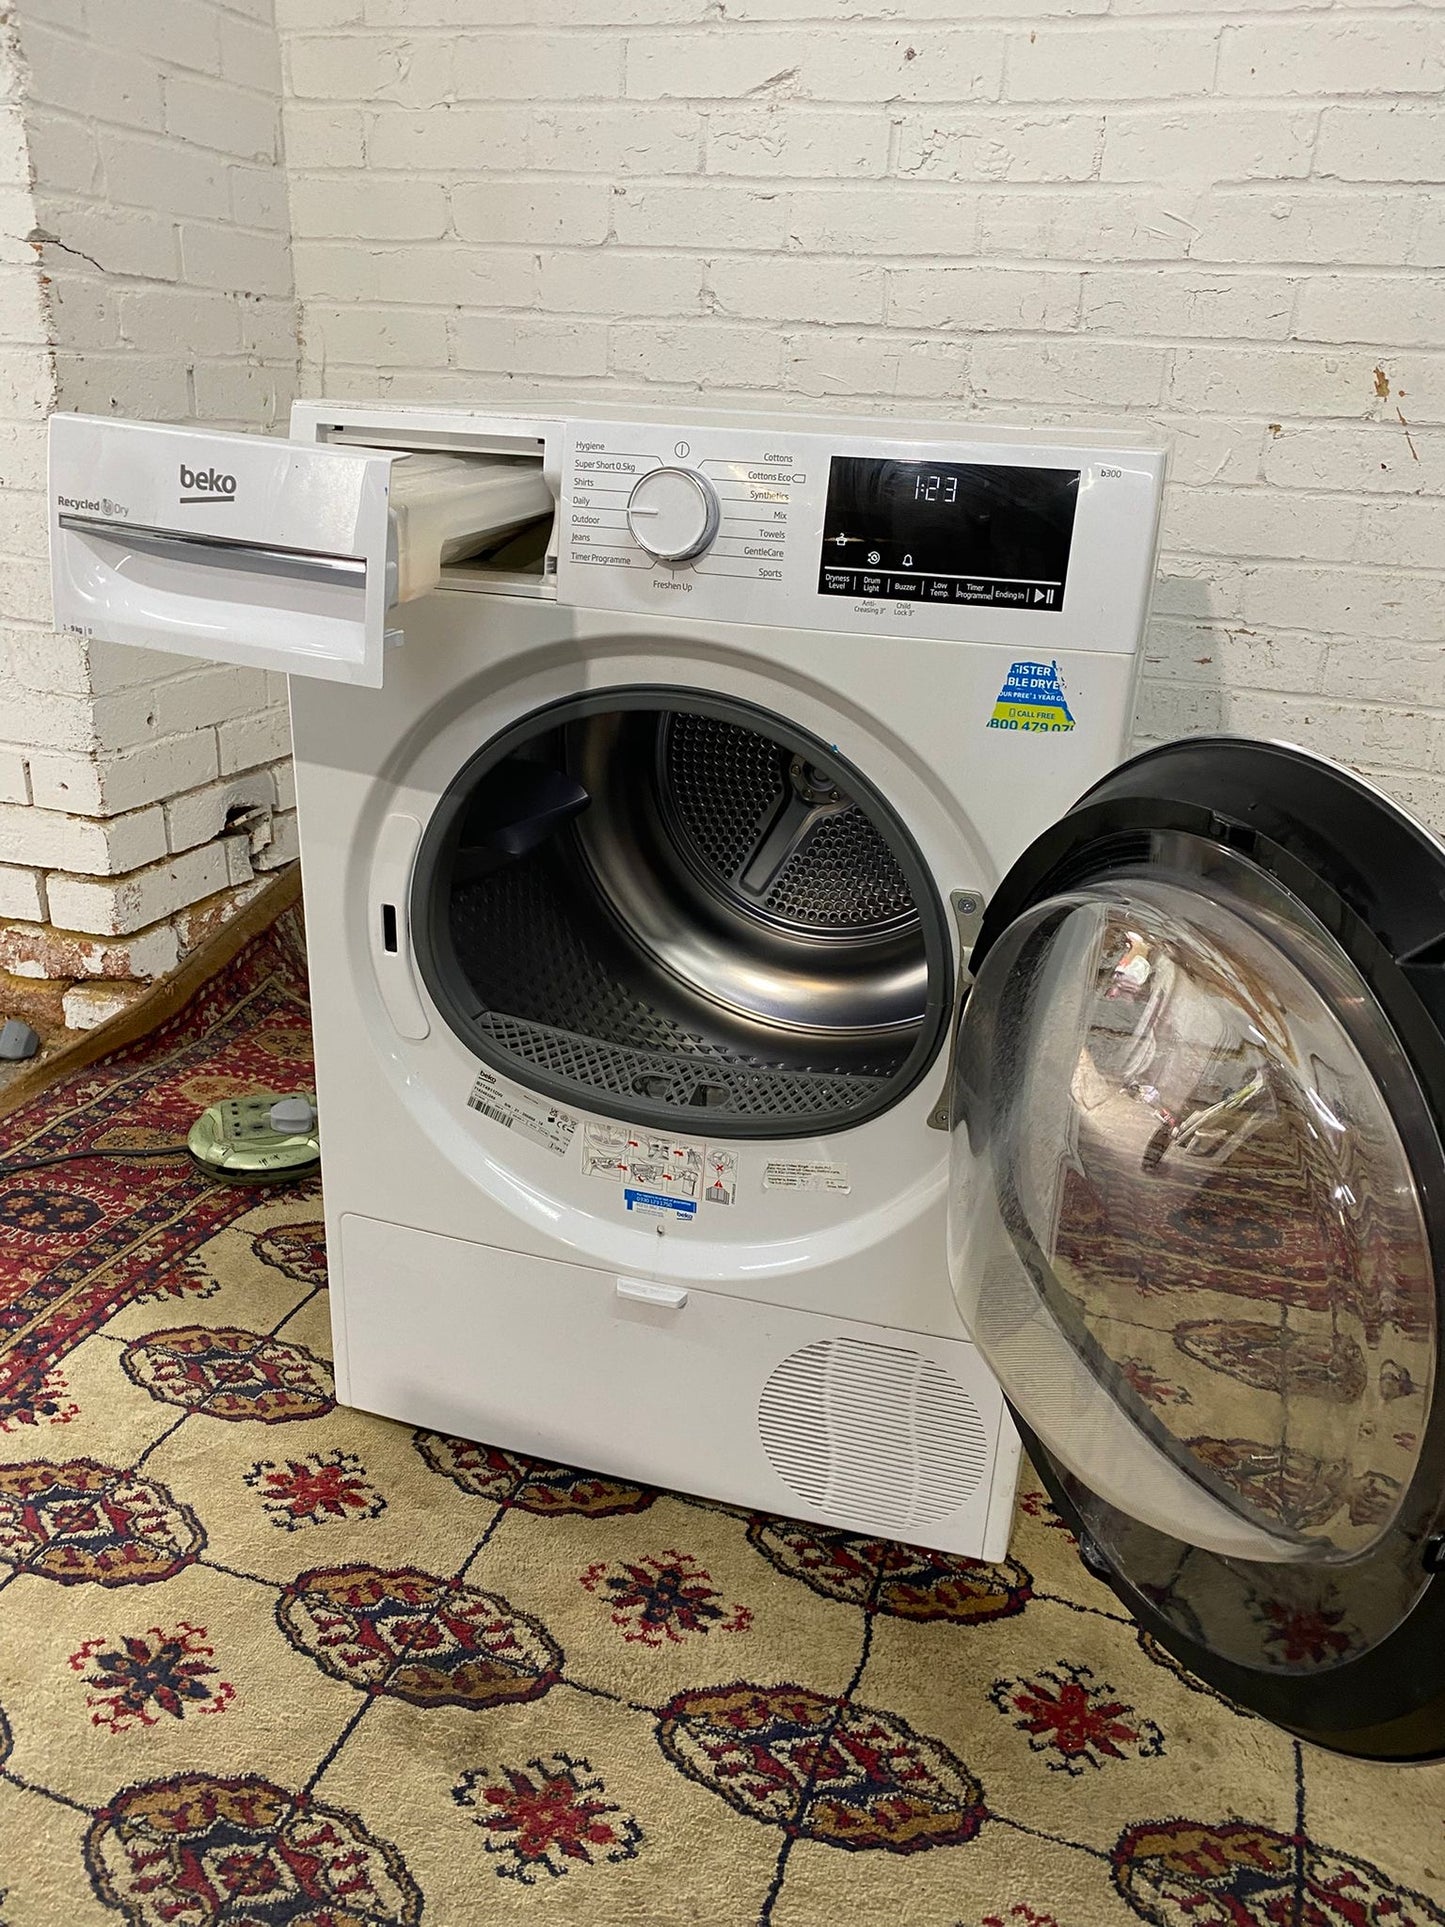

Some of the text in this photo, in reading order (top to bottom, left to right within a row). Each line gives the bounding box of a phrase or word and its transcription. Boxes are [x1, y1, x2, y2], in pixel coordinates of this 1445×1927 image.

[576, 441, 605, 451] Hygiene
[764, 453, 793, 462] Cottons
[575, 460, 636, 472] Super Short 0.5kg
[180, 464, 237, 494] beko
[748, 471, 792, 482] Cottons Eco
[1100, 470, 1122, 479] b300
[574, 478, 594, 487] Shirts
[750, 490, 789, 500] Synthetics
[573, 496, 590, 506] Daily
[58, 496, 129, 518] Recycled Dry
[572, 515, 600, 524] Outdoor
[774, 512, 787, 520] Mix
[571, 533, 591, 542] Jeans
[759, 529, 785, 539] Towels
[744, 546, 784, 557] GentleCare
[571, 552, 631, 565] Timer Programme
[759, 568, 783, 578] Sports
[825, 573, 850, 583] Dryness
[864, 576, 881, 584] Drum
[933, 581, 948, 589] Low
[653, 580, 692, 592] Freshen Up
[828, 582, 846, 590] Level
[864, 585, 880, 593] Light
[894, 583, 916, 591] Buzzer
[967, 583, 984, 591] Timer
[957, 591, 992, 600] Programme
[995, 590, 1017, 600] Ending
[1007, 676, 1060, 690] BLE DRYE
[1017, 710, 1056, 720] CALL FREE
[986, 718, 1074, 732] 800 479 07
[480, 1070, 497, 1083] beko
[677, 1211, 693, 1219] beko
